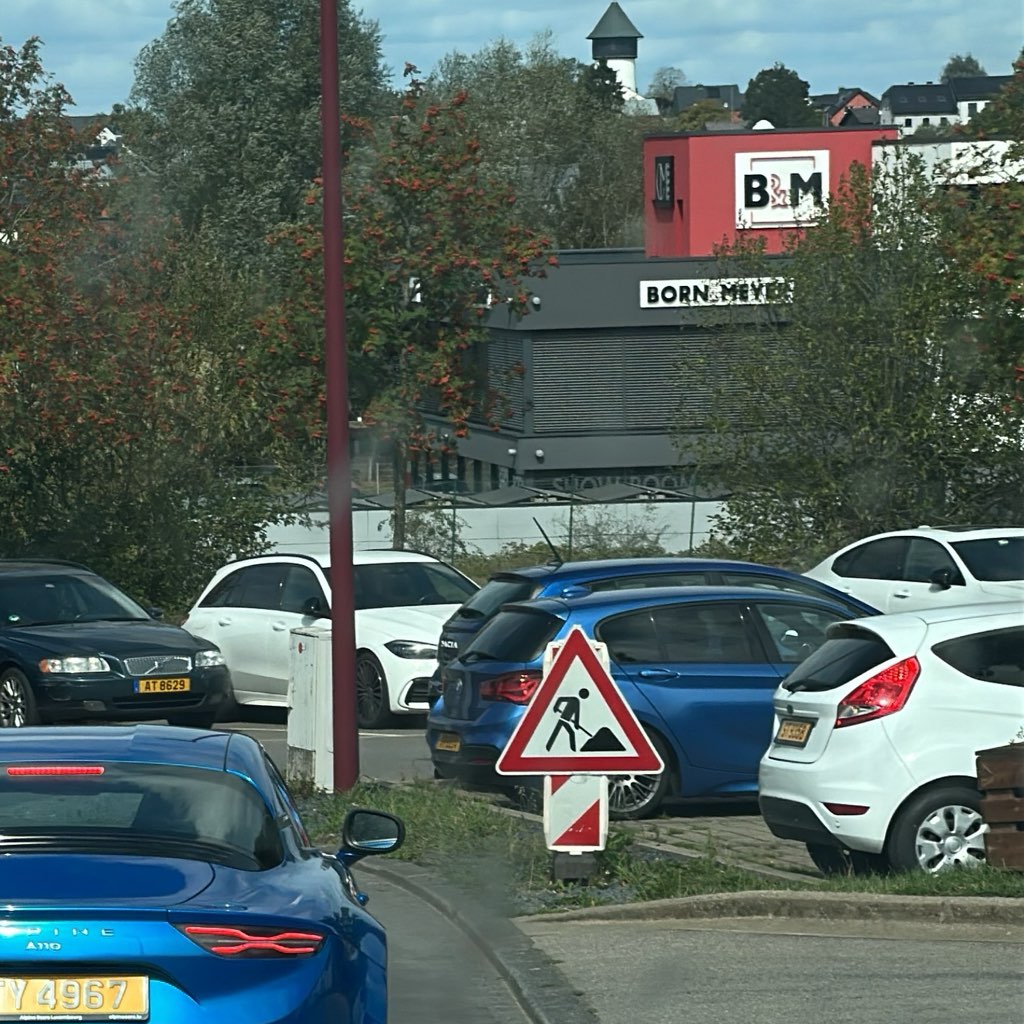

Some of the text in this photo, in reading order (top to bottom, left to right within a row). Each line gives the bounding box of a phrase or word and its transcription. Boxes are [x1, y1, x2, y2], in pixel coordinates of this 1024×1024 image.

[744, 172, 823, 209] B&M
[647, 284, 709, 304] BORN
[145, 680, 185, 691] AT 8629
[25, 940, 62, 950] A110
[36, 979, 129, 1010] 4967
